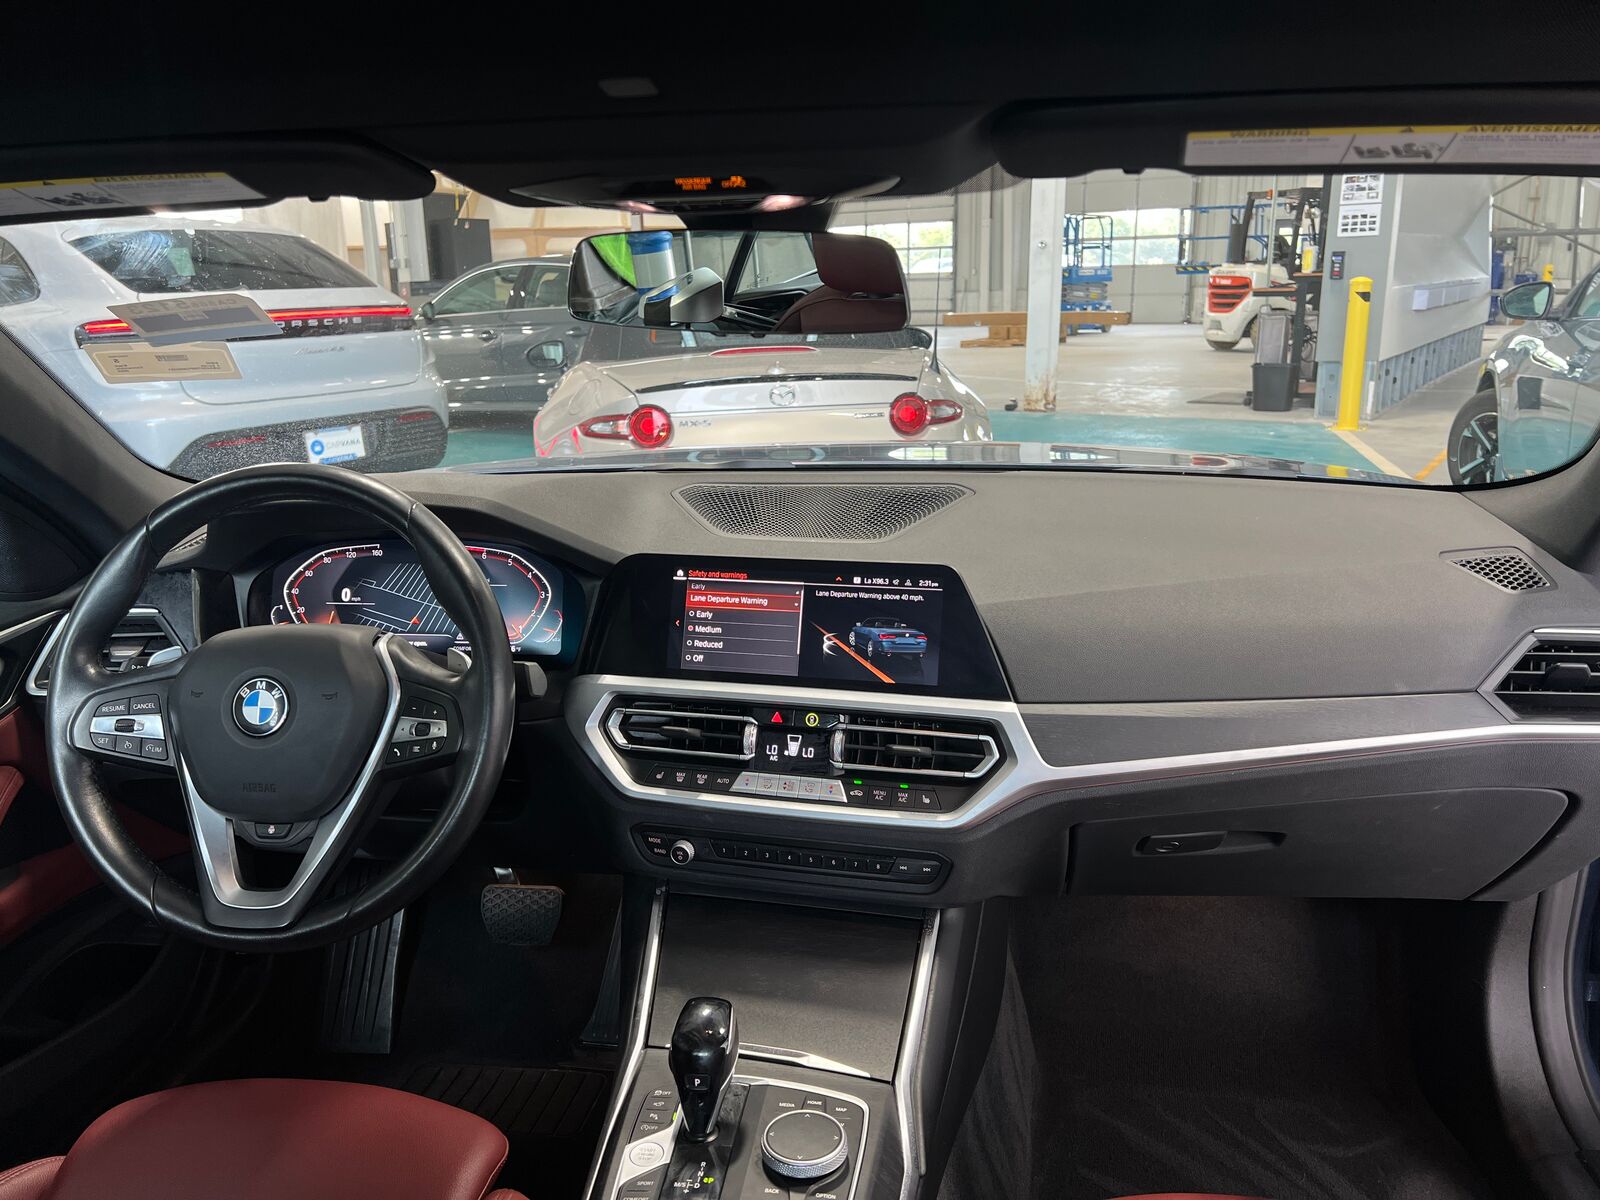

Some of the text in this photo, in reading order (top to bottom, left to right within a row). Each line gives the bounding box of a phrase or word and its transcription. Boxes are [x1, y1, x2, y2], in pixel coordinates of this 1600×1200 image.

[678, 419, 712, 428] MX-5
[372, 549, 383, 557] 160
[481, 552, 487, 560] 6
[527, 571, 533, 579] 4
[688, 570, 707, 578] Safety
[720, 572, 748, 580] warnings
[691, 582, 706, 591] Early
[291, 587, 299, 595] 40
[341, 587, 351, 602] 0
[540, 591, 546, 599] 3
[690, 594, 768, 606] Lane Departure Warning
[859, 592, 882, 600] Warning
[883, 592, 900, 600] above
[696, 611, 713, 620] Early
[695, 625, 722, 633] Medium
[693, 640, 723, 649] Reduced
[692, 654, 704, 662] Off
[240, 681, 283, 699] BMW
[101, 704, 126, 712] RESUME
[133, 702, 155, 710] CANCEL
[766, 744, 778, 755] LO
[802, 747, 815, 758] LO
[694, 1078, 701, 1087] P
[815, 1192, 836, 1200] OPTION
